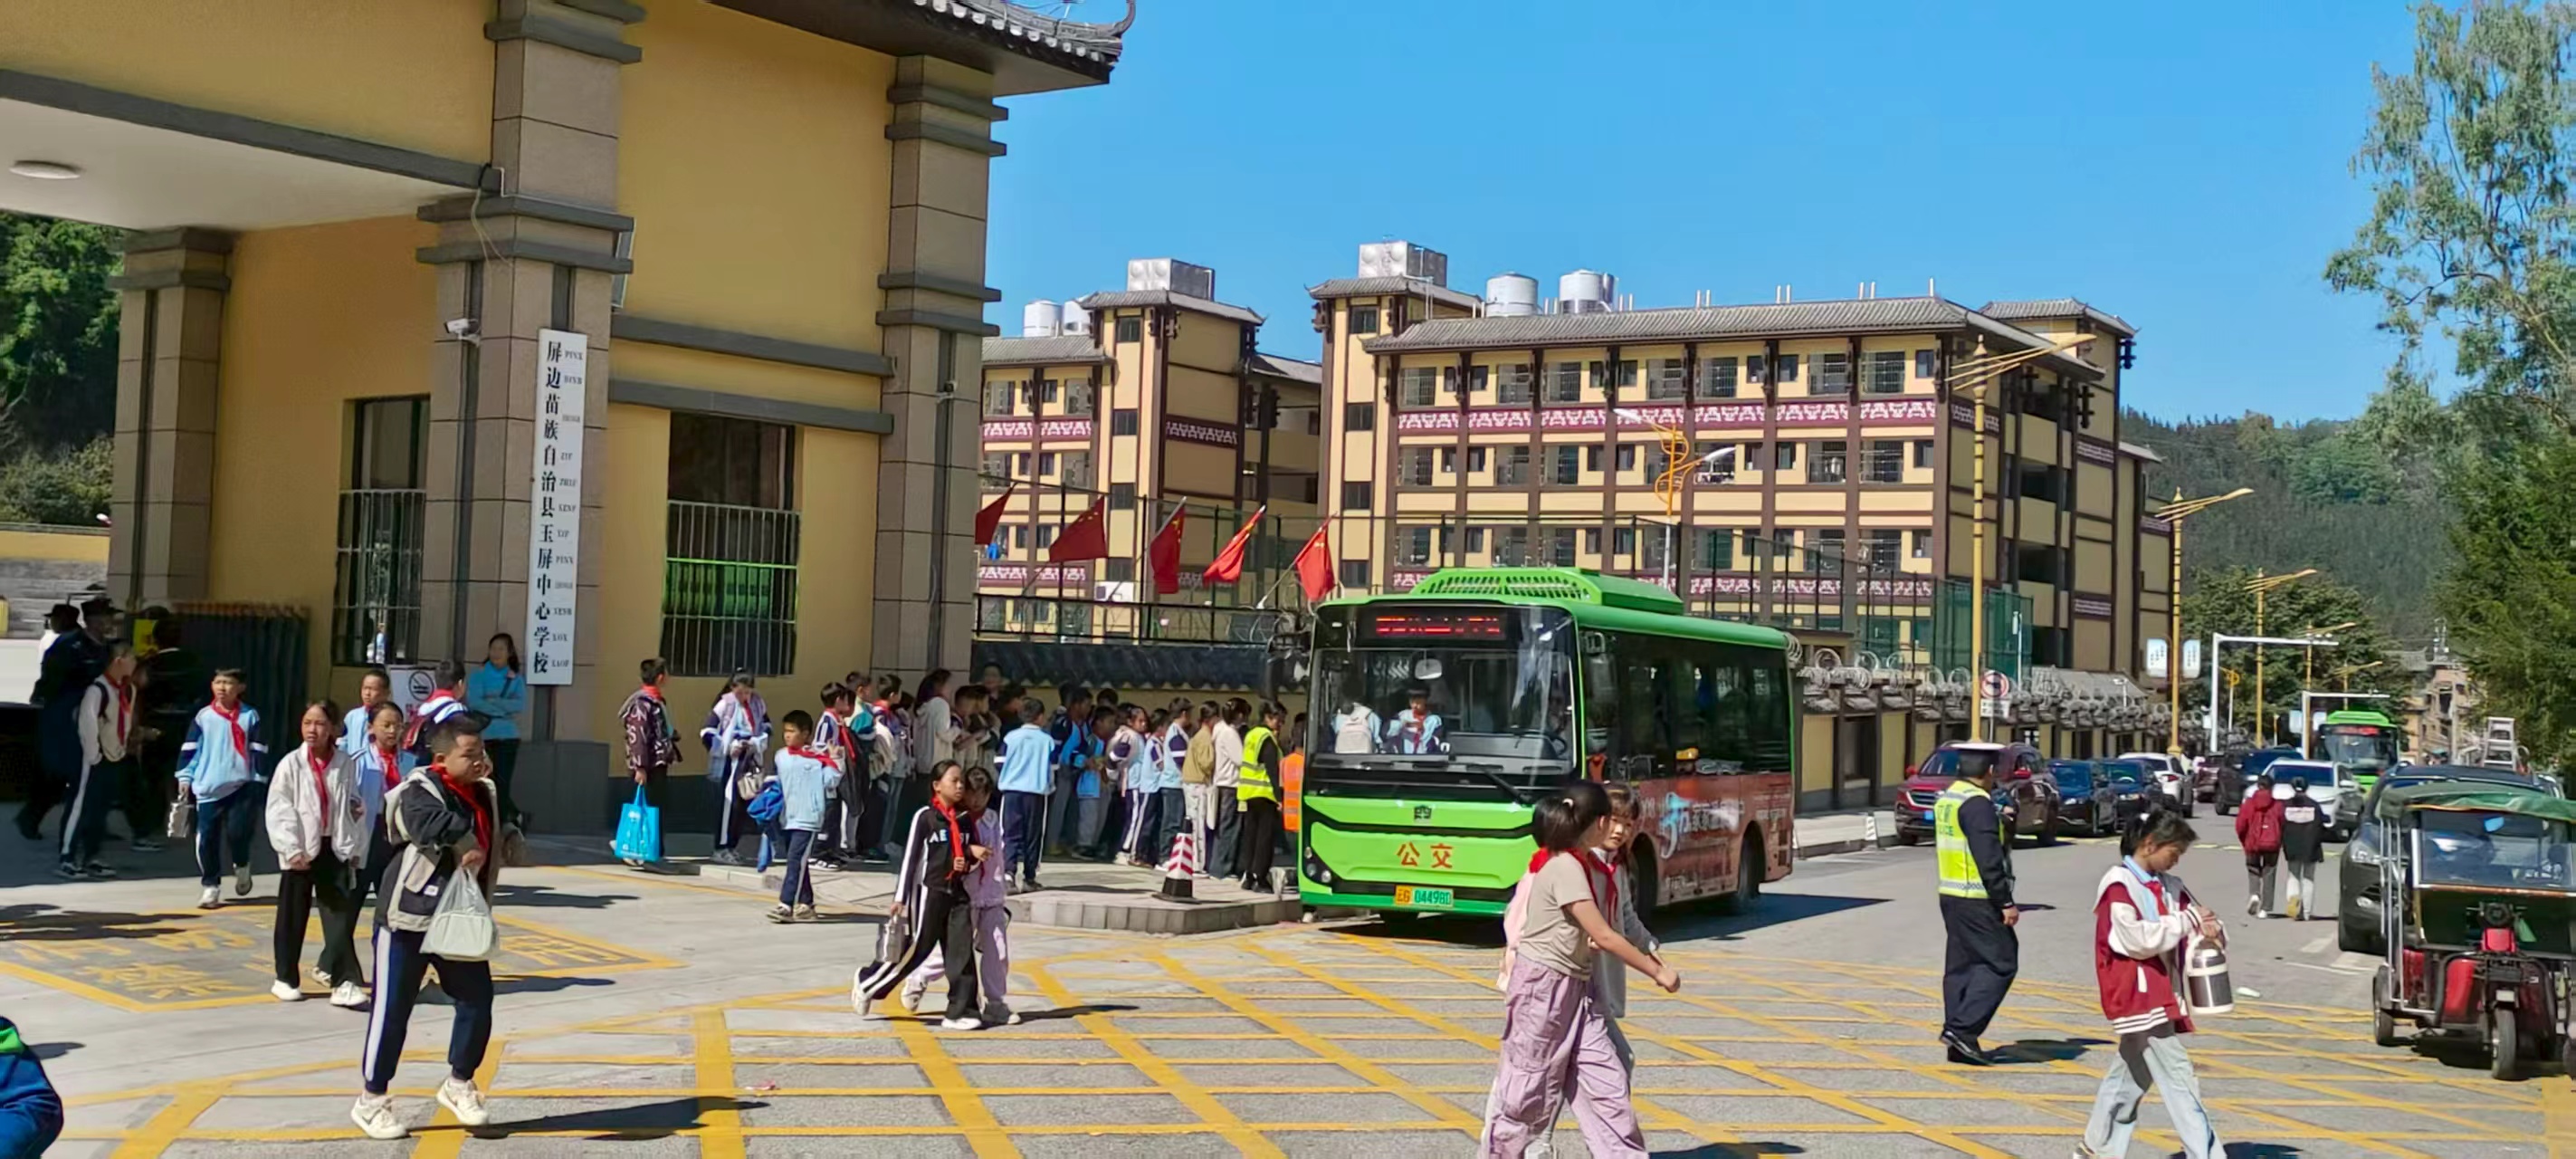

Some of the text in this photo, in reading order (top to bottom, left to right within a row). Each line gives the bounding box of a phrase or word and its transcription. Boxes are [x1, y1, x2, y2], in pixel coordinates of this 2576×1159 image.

[534, 340, 562, 674] 屏边苗族自治县玉屏中心学校
[1397, 841, 1453, 869] 公交
